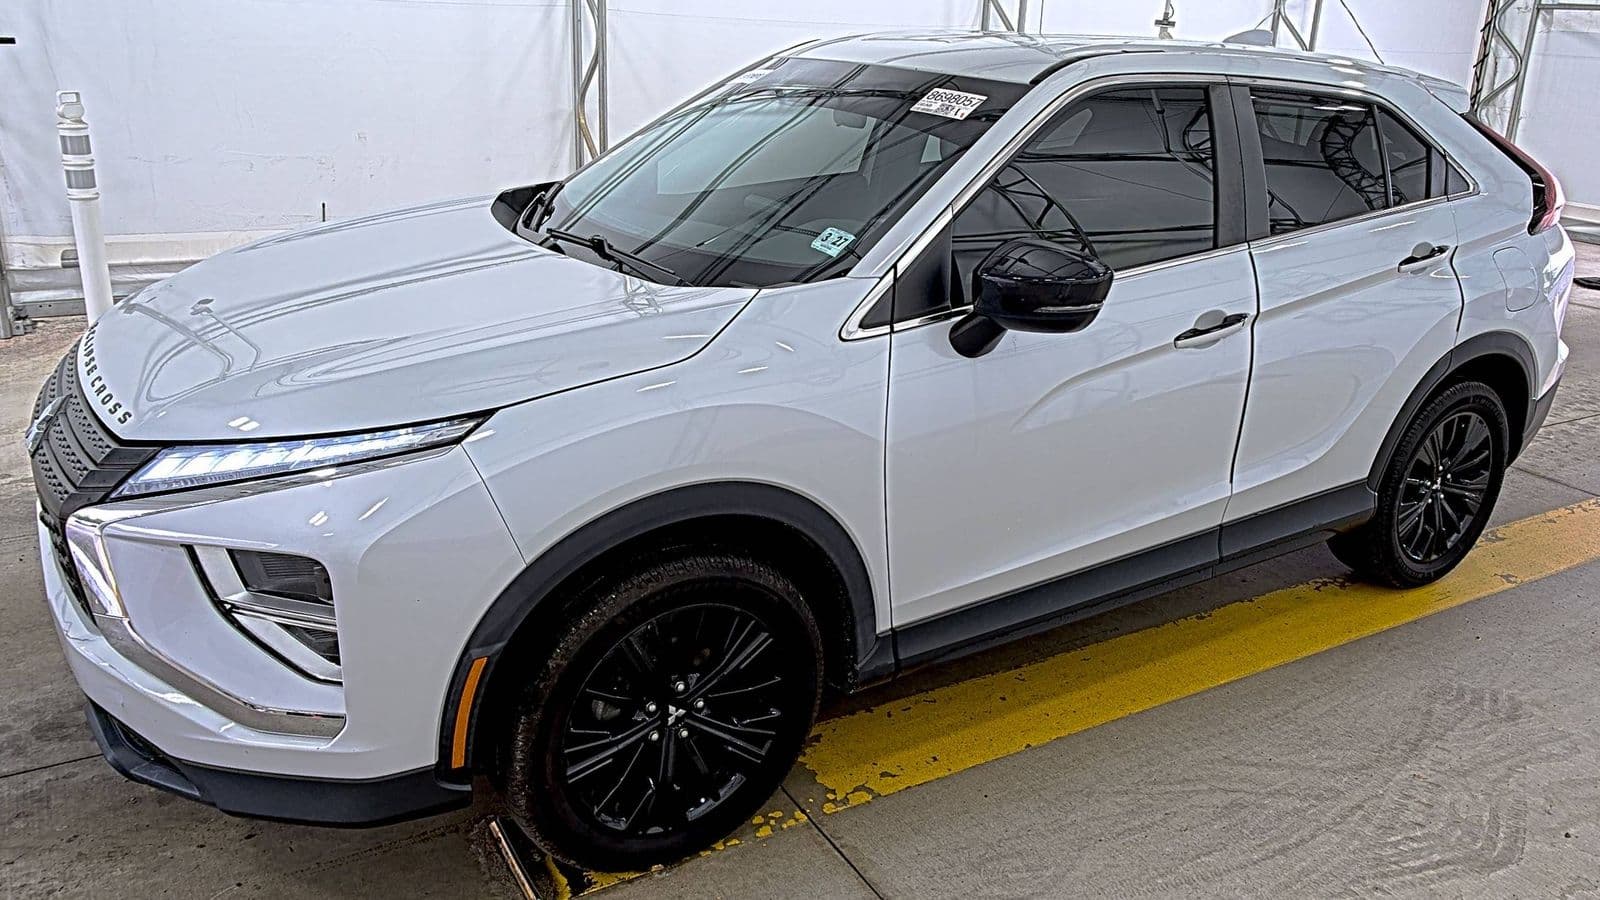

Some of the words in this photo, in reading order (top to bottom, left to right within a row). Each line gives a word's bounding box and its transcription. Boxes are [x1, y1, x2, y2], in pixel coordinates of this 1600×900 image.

[926, 90, 985, 107] 8698057
[821, 232, 833, 242] 3
[831, 236, 849, 247] 27
[90, 375, 132, 424] CROSS
